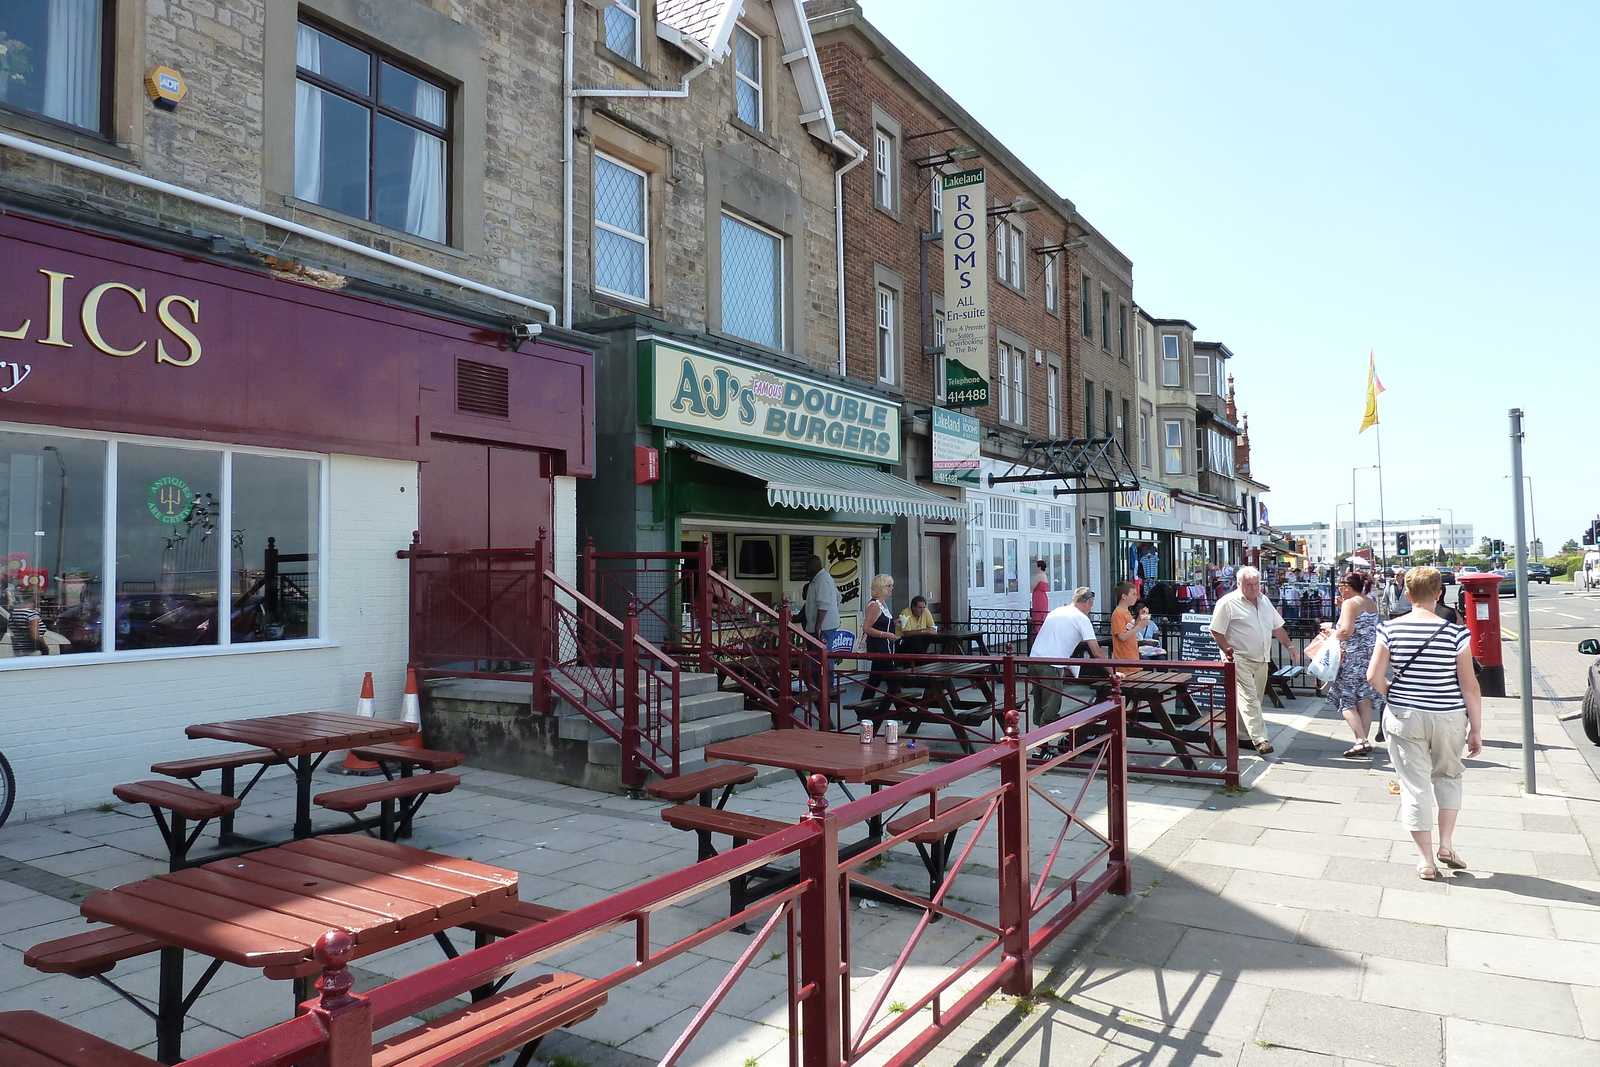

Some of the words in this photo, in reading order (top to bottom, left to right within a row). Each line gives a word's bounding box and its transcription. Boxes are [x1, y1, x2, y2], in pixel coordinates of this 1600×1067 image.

[160, 78, 179, 91] ADT
[944, 172, 983, 188] Lakeland
[954, 194, 977, 289] ROOMS
[957, 296, 975, 308] ALL
[947, 308, 985, 321] En-suite
[949, 338, 983, 347] Overlooking
[967, 345, 977, 353] Bay
[948, 376, 981, 385] Telephone
[947, 388, 986, 402] 414488
[753, 379, 783, 398] FAMOUS
[783, 382, 888, 430] DOUBLE
[934, 411, 960, 432] Lakeland
[764, 408, 890, 455] BURGERS
[963, 423, 978, 435] ROOMS
[939, 472, 958, 483] 414488
[151, 477, 192, 498] ANTIQUES
[147, 502, 162, 519] ARE
[163, 506, 190, 523] GREEN
